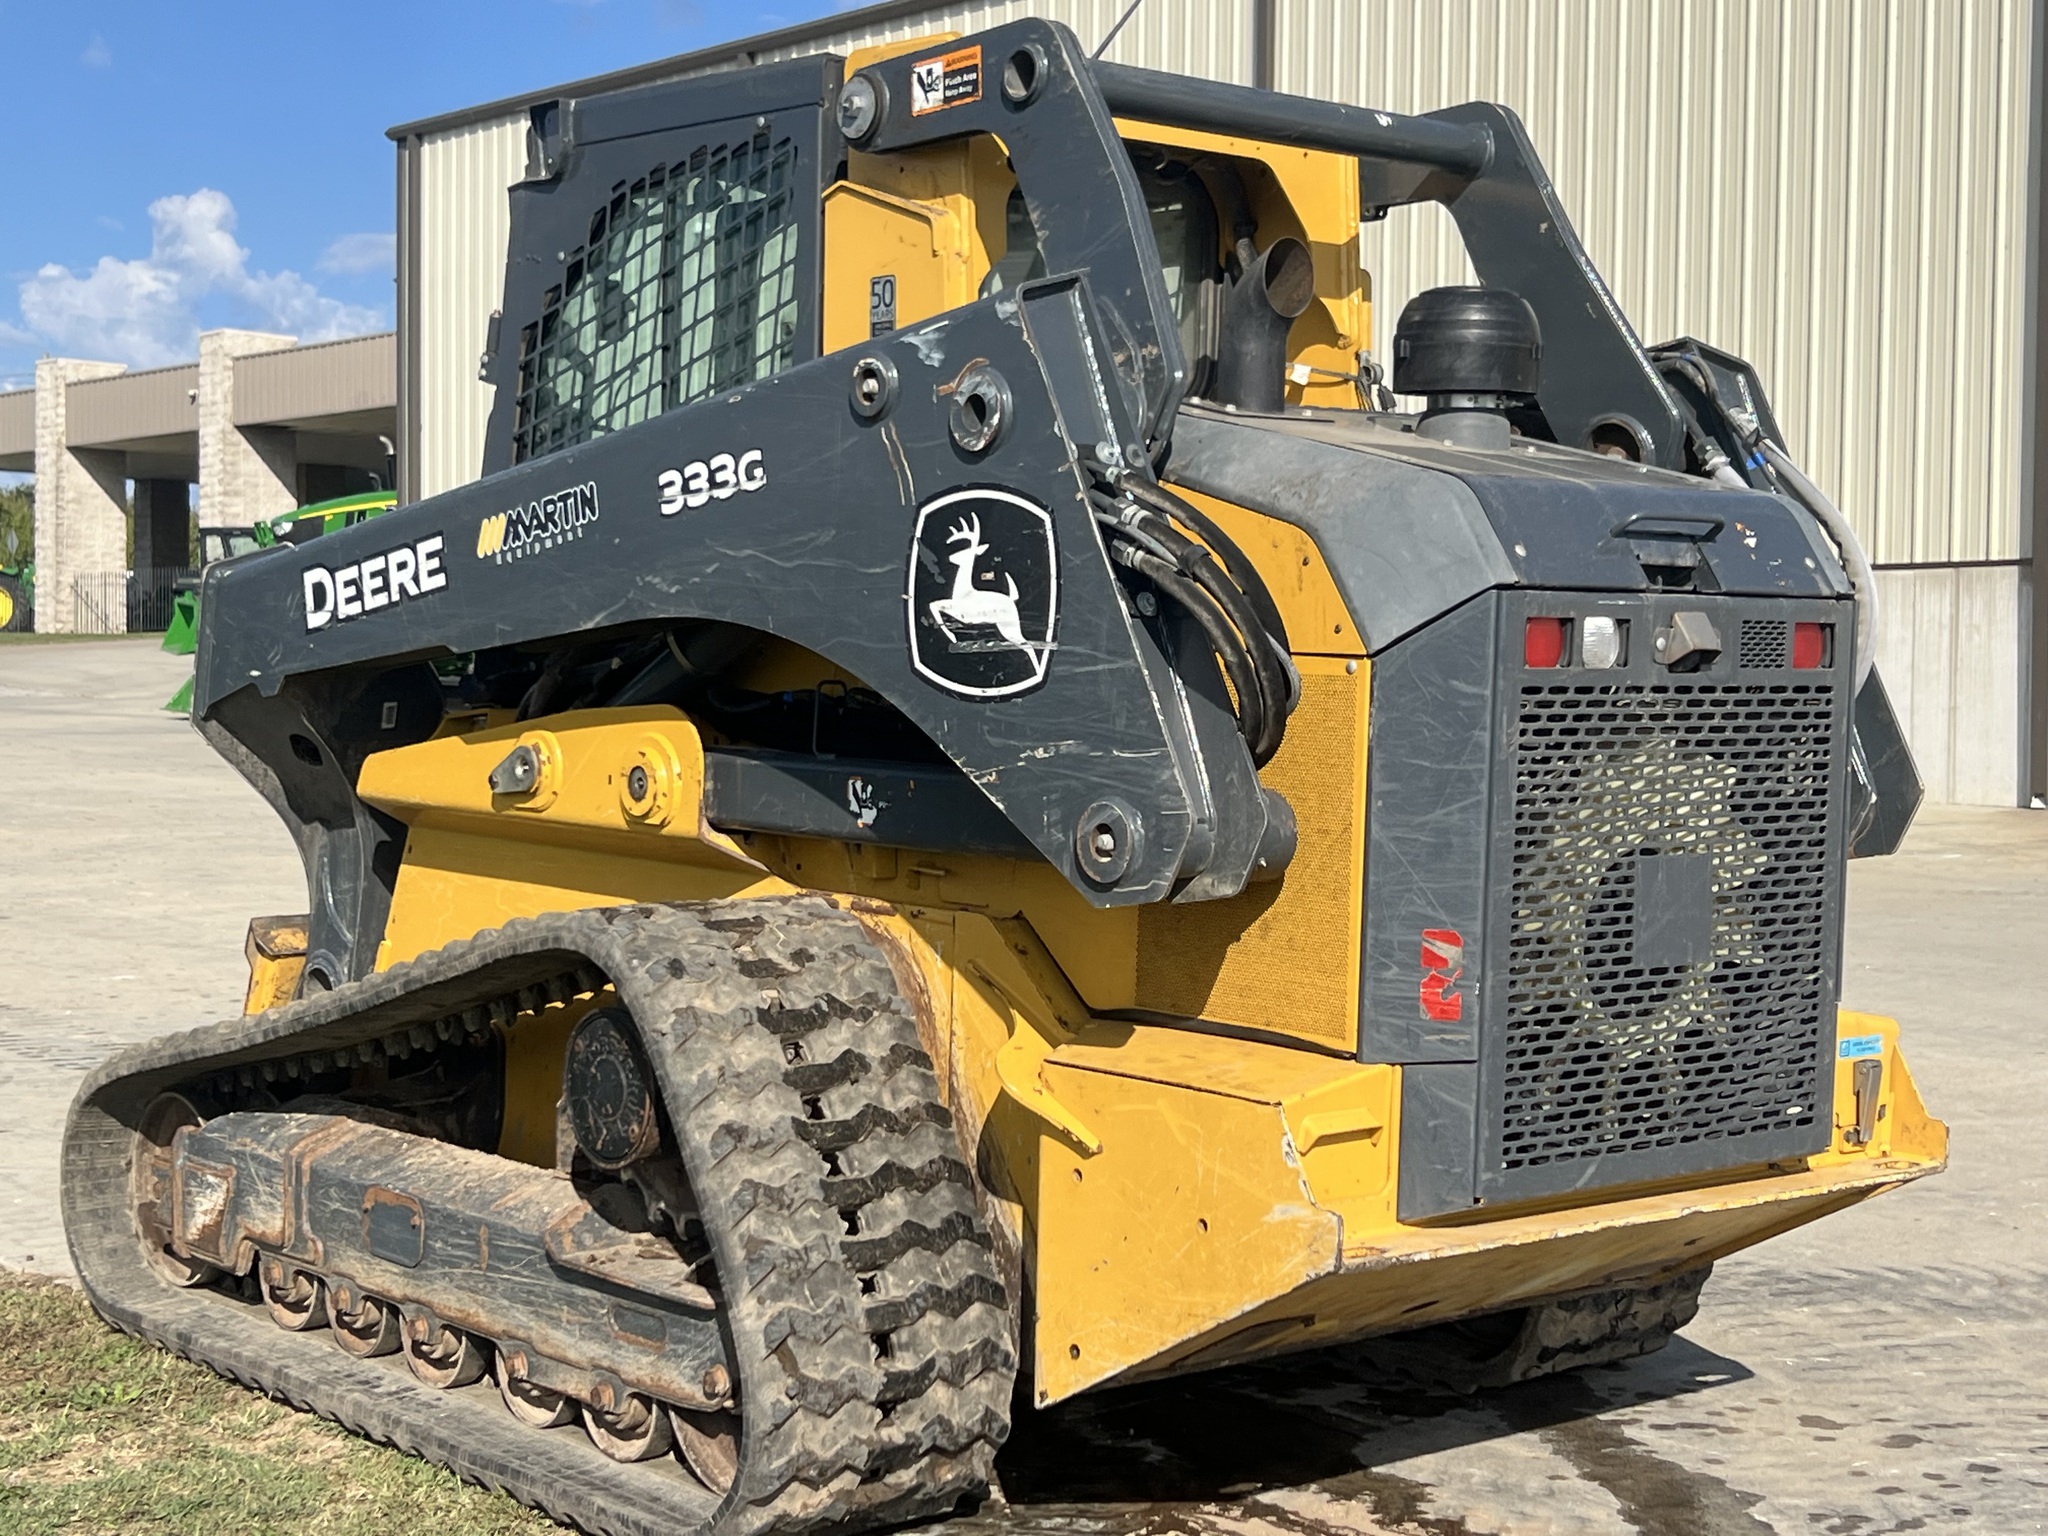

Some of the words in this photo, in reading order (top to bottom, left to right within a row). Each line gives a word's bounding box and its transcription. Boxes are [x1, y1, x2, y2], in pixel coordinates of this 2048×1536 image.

[872, 279, 894, 310] 50
[501, 481, 599, 551] MARTIN
[658, 449, 767, 515] 333G
[303, 535, 446, 629] DEERE
